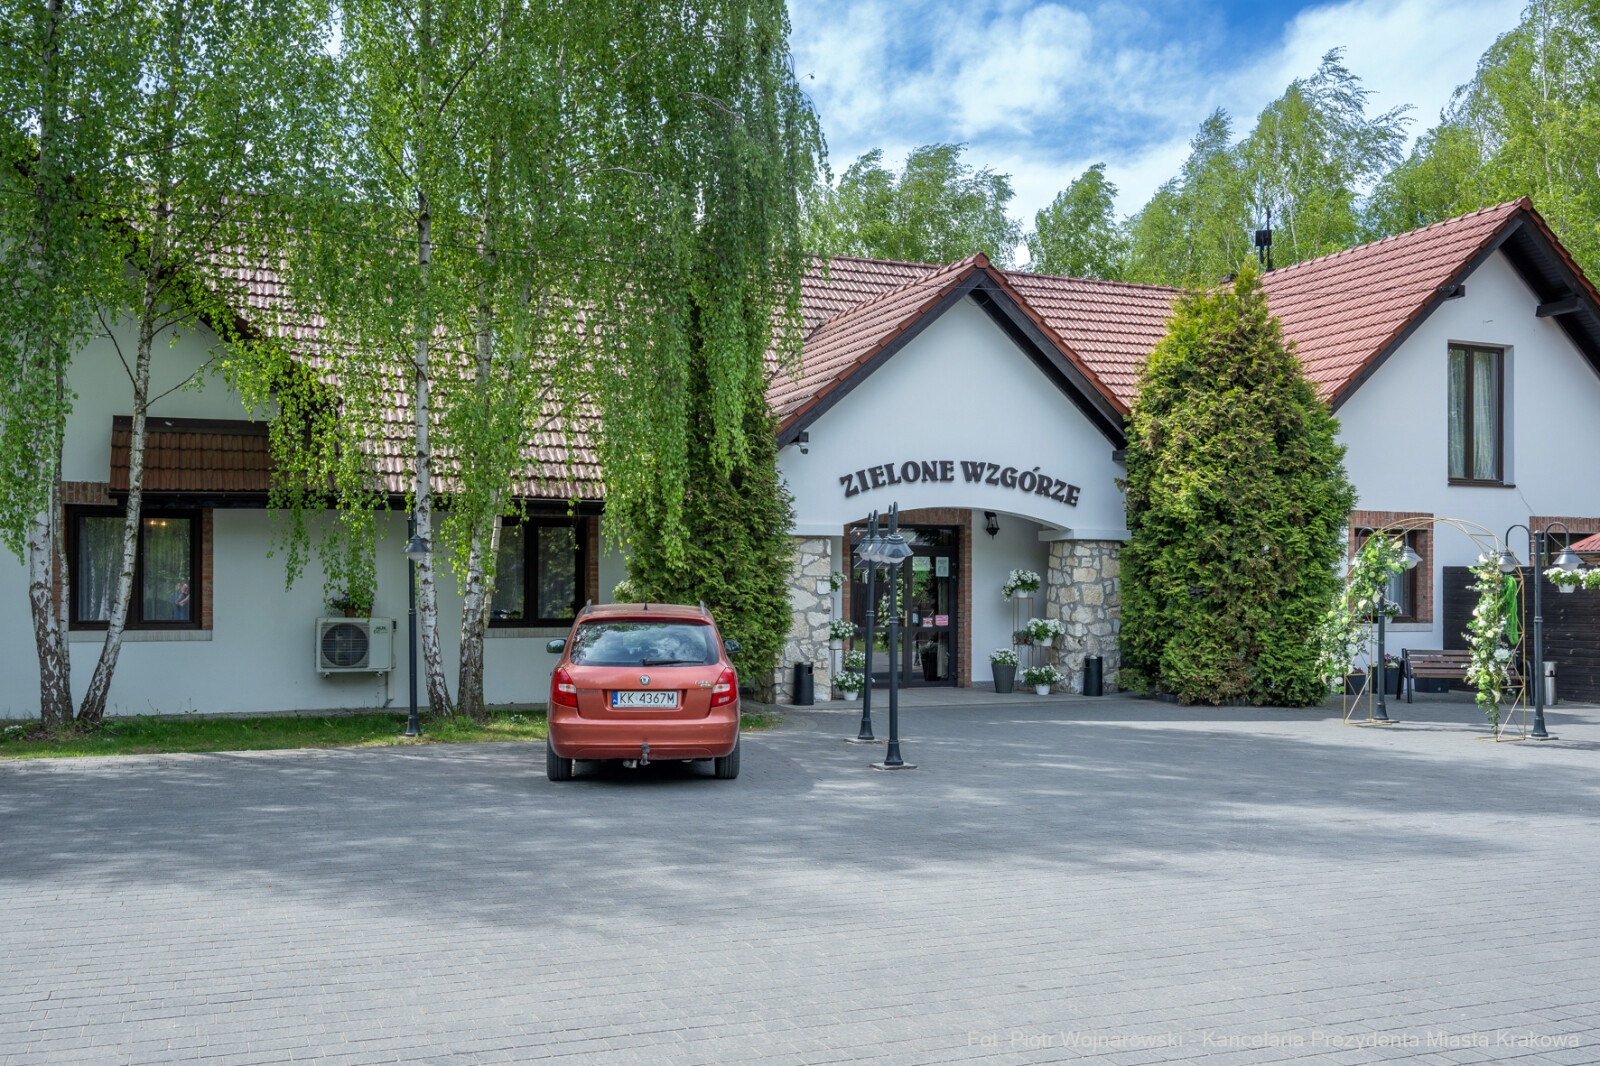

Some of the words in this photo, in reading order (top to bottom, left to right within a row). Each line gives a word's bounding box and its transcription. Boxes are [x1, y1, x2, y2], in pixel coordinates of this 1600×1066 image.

[839, 460, 954, 498] ZIELONE
[960, 460, 1081, 507] WZGÓRZE
[620, 692, 634, 704] KK
[639, 692, 675, 704] 4367M
